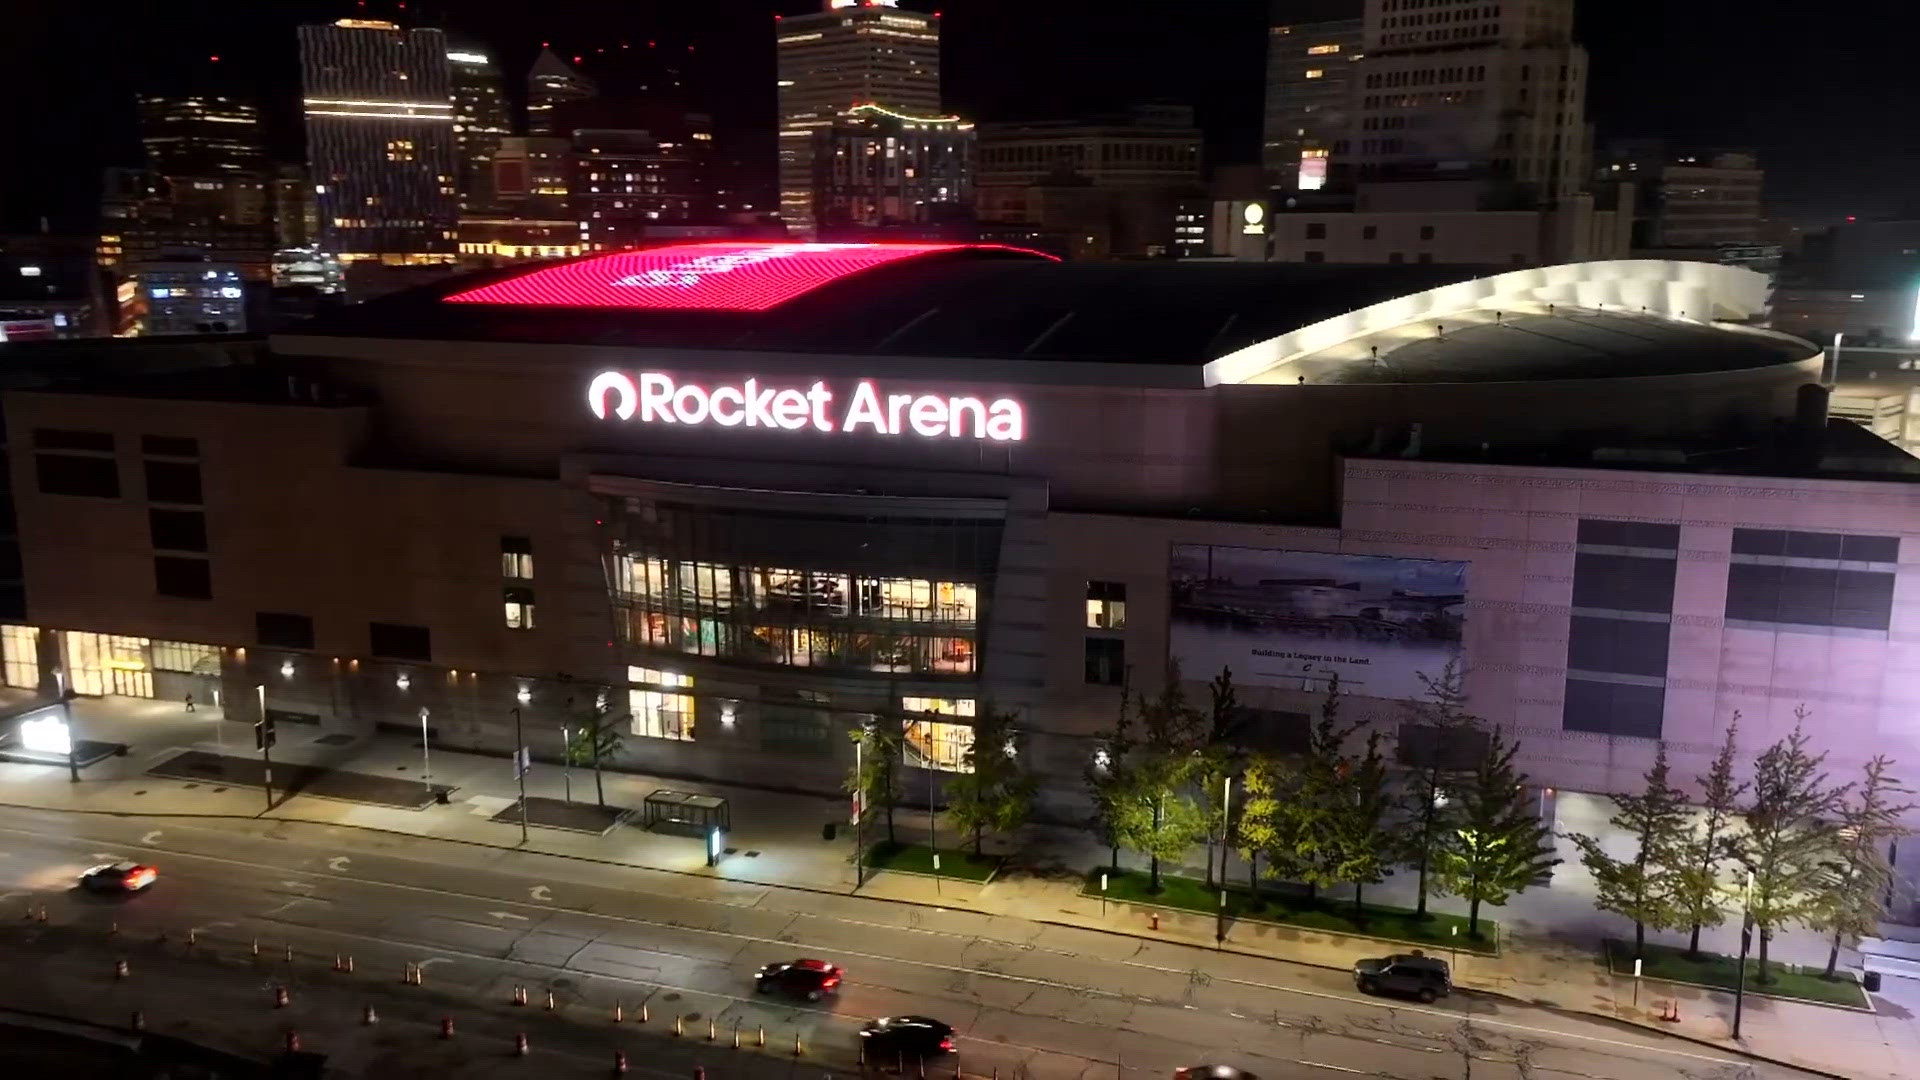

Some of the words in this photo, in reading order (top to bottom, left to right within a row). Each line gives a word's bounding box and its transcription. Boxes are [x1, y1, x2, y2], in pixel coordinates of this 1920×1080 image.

[640, 372, 833, 432] Rocket
[843, 381, 1023, 441] Arena
[1251, 649, 1285, 659] Building
[1294, 652, 1322, 662] Legacy
